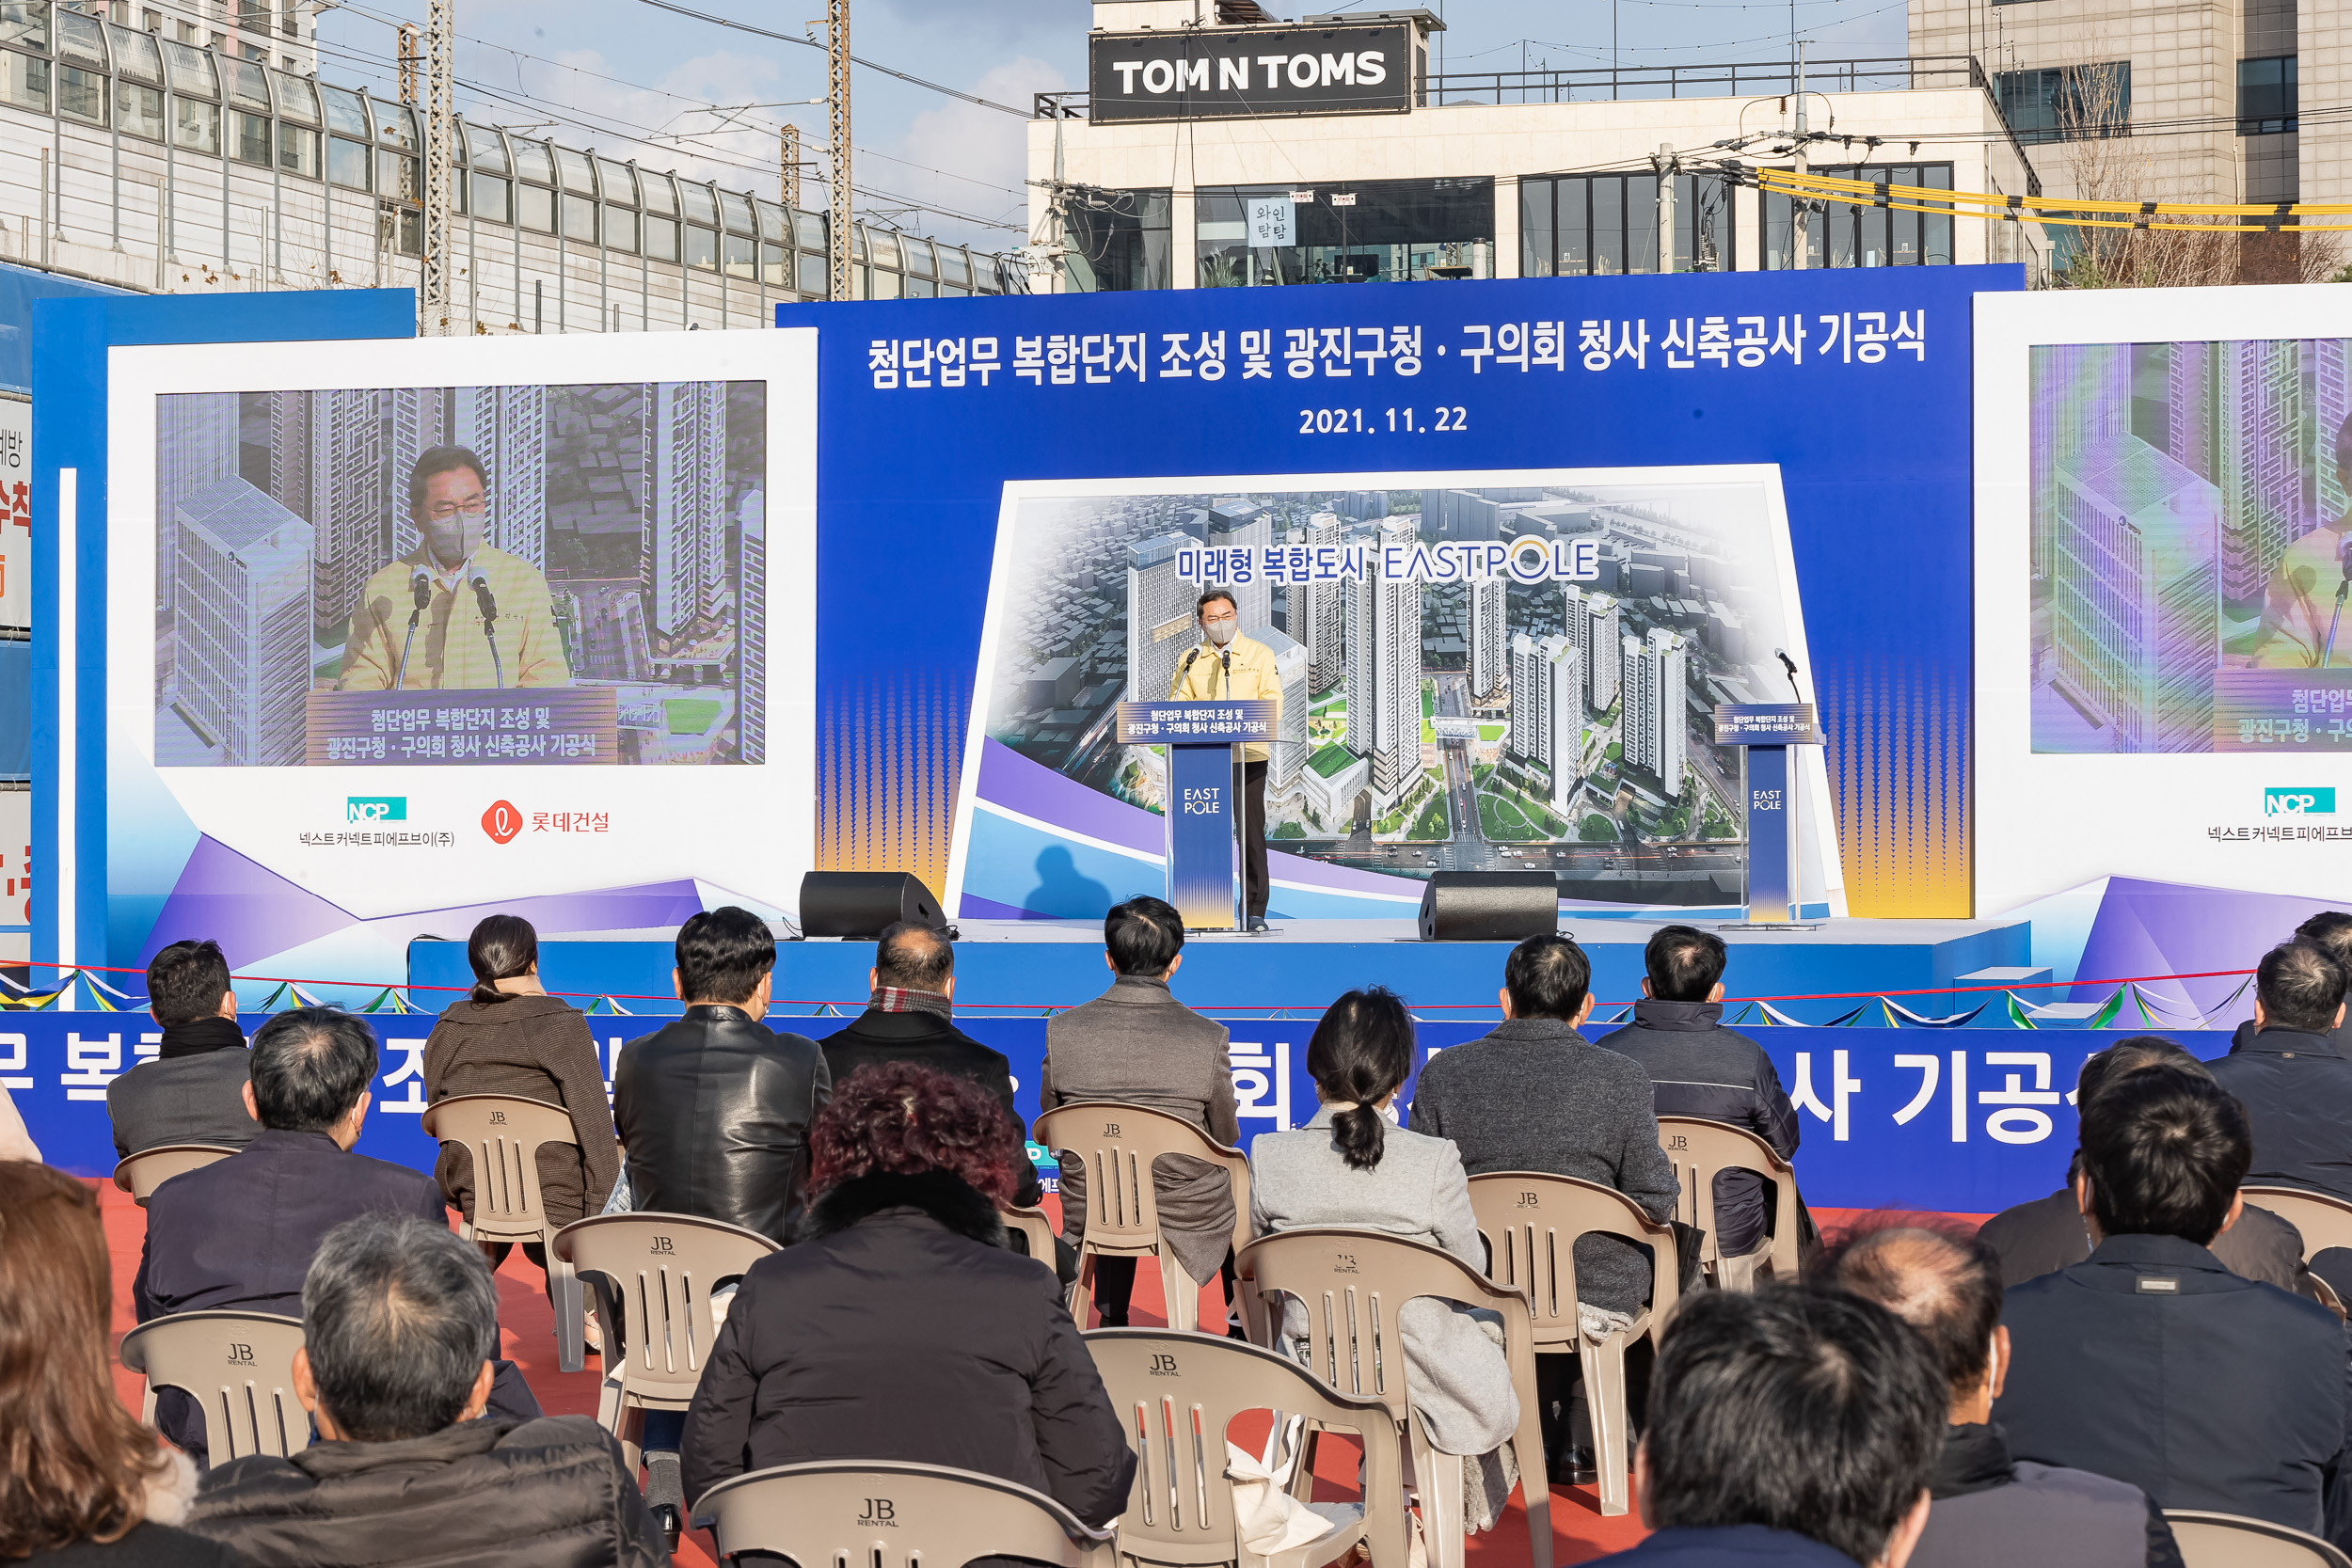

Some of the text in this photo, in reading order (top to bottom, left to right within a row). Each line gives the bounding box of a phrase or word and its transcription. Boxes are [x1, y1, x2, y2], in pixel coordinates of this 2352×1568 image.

[1113, 50, 1387, 94] TOM N TOMS
[1256, 204, 1285, 222] 와인
[1258, 222, 1287, 240] 탐탐
[867, 337, 1001, 389] 첨단업무
[1012, 332, 1146, 386] 복합단지
[1159, 330, 1226, 381] 조성
[1240, 328, 1273, 380] 및
[1283, 325, 1422, 379] 광진구청
[1460, 321, 1565, 374] 구의회
[1578, 318, 1650, 372] 청사
[1660, 313, 1807, 369] 신축공사
[1818, 309, 1925, 364] 기공식
[1299, 406, 1468, 435] 2021. 11. 22
[1179, 539, 1598, 584] 미래형 복합도시 EASTPOLE
[371, 706, 550, 732] 첨단업무 복합단지 조성 및
[1150, 708, 1244, 721] 첨단업무 복합단지 조성 및
[1166, 722, 1190, 734] 구의회
[1191, 721, 1208, 734] 청사
[1242, 721, 1267, 733] 기공식
[2237, 718, 2310, 744] 광진구청
[326, 736, 387, 760] 광진구청
[401, 735, 446, 759] 구의회
[450, 735, 481, 758] 청사
[485, 734, 547, 758] 신축공사
[550, 733, 596, 757] 기공식
[1184, 787, 1220, 800] EAST
[1753, 790, 1782, 800] EAST
[348, 802, 390, 821] NCP
[1184, 800, 1220, 816] POLE
[1753, 800, 1782, 811] POLE
[2266, 794, 2316, 815] NCP
[532, 812, 609, 832] 롯데건설
[1891, 1050, 2079, 1145] 기공
[489, 1111, 506, 1122] JB
[1103, 1123, 1120, 1135] JB
[1668, 1135, 1688, 1148] JB
[1518, 1192, 1538, 1205] JB
[650, 1236, 674, 1251] JB
[228, 1342, 254, 1361] JB
[1150, 1354, 1177, 1371] JB
[858, 1497, 896, 1520] JB
[857, 1519, 899, 1528] RENTAL
